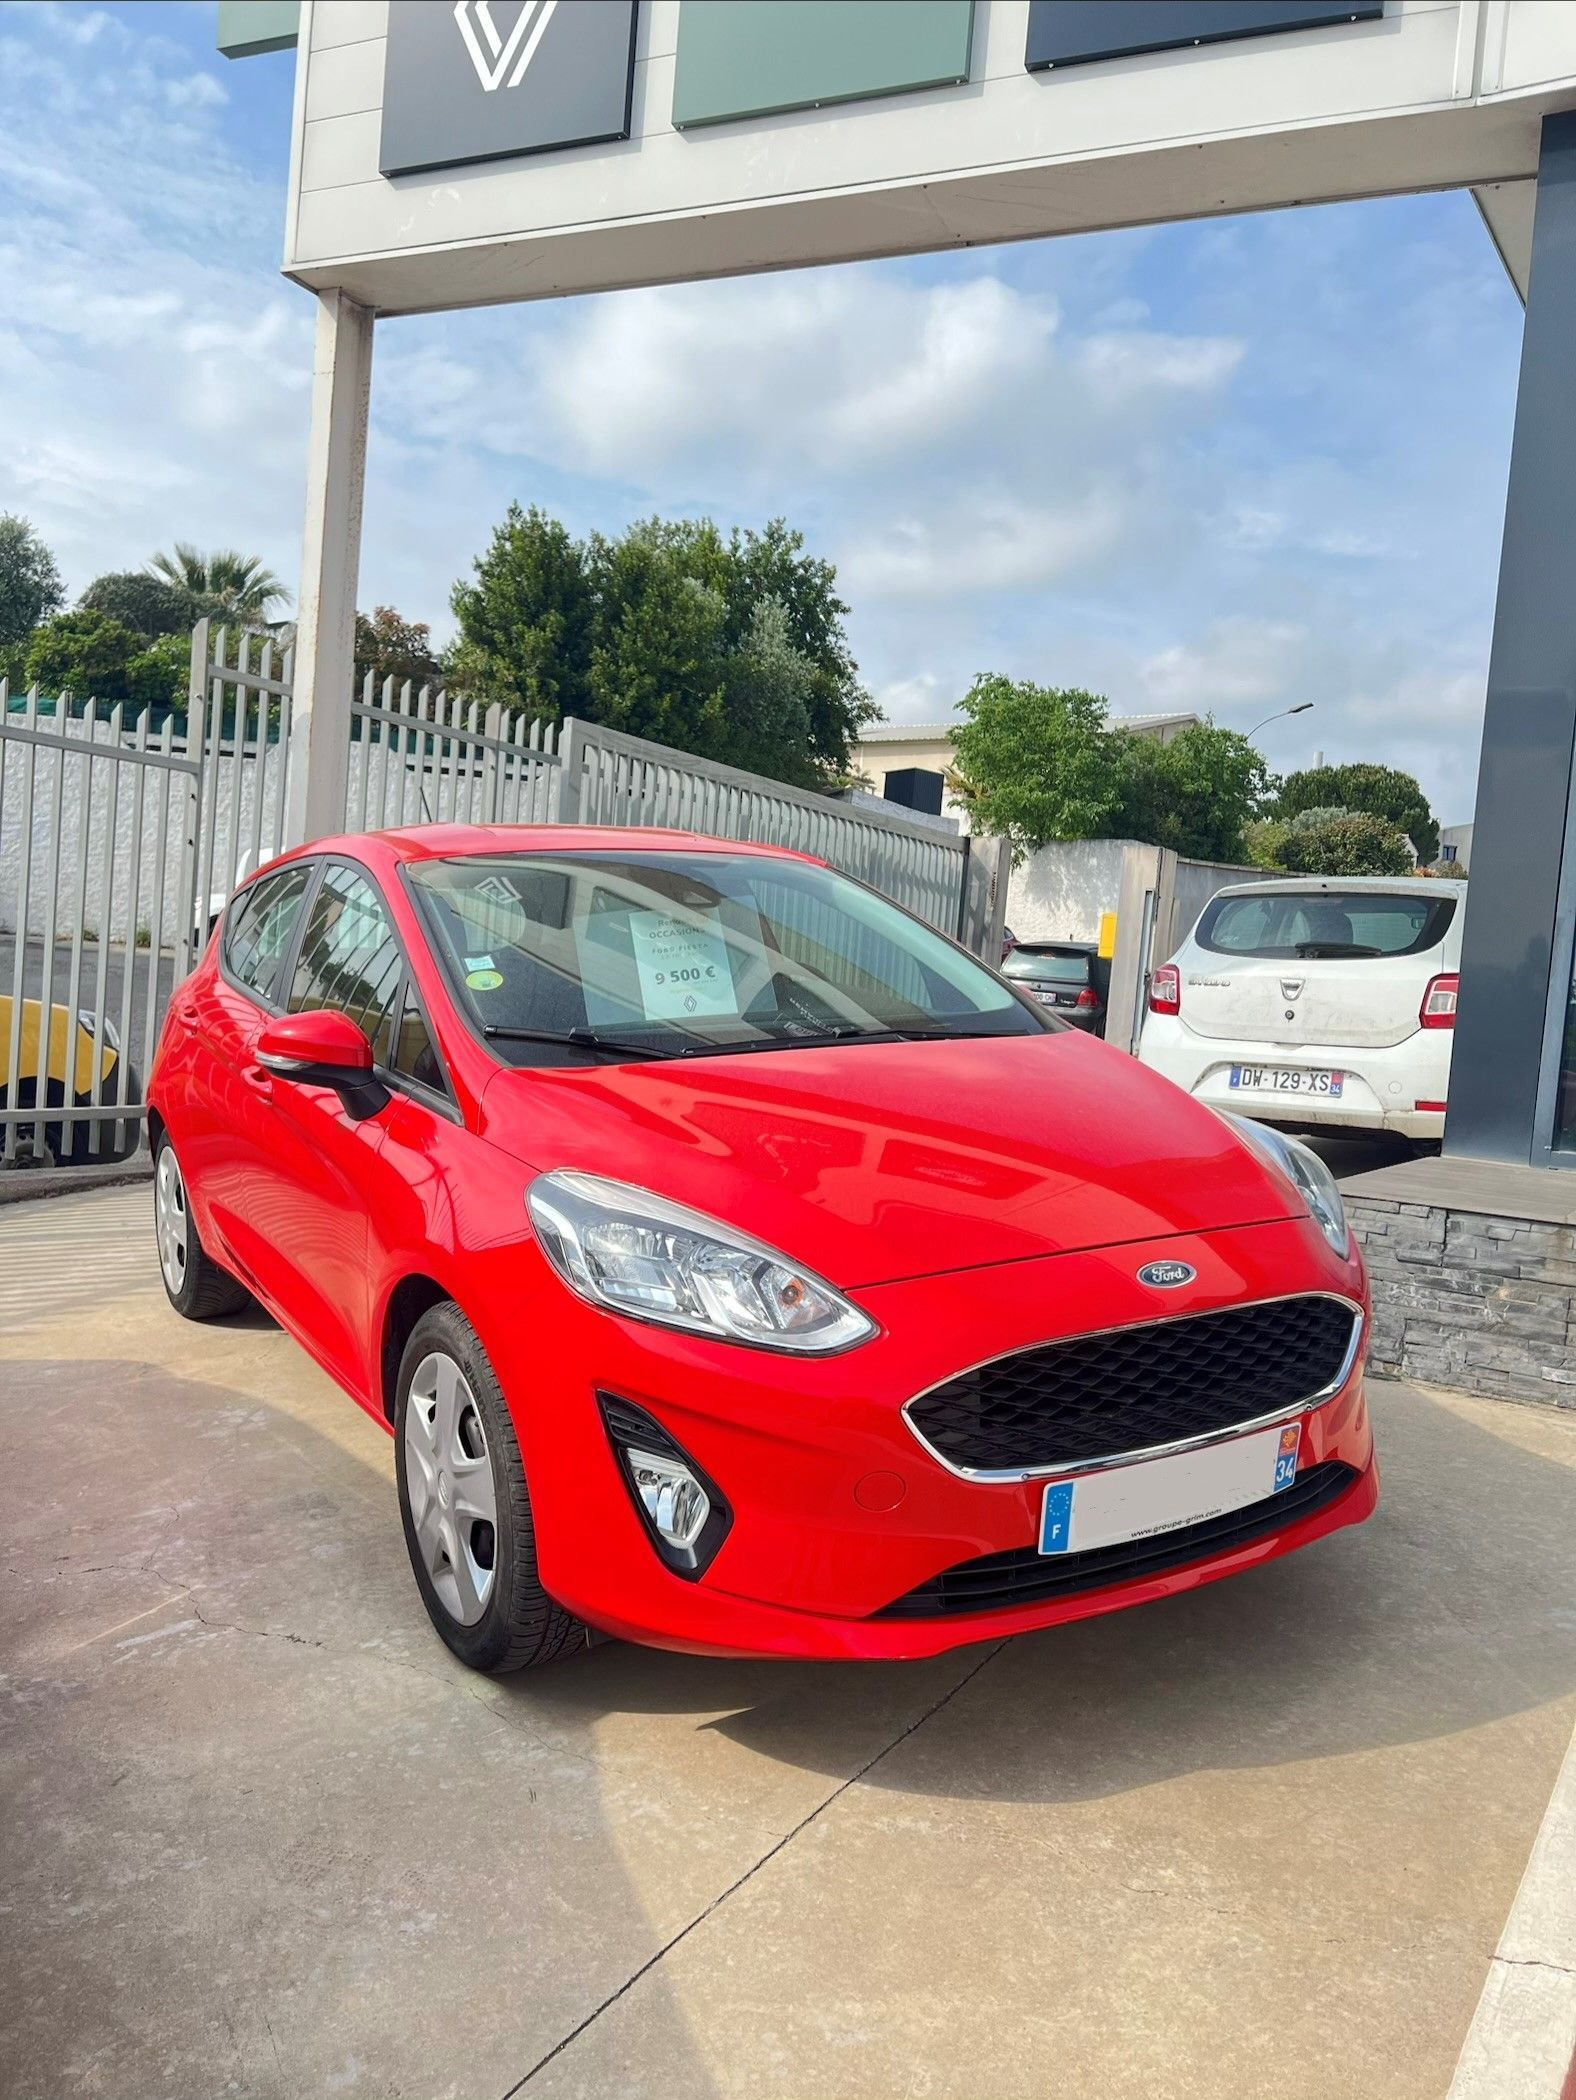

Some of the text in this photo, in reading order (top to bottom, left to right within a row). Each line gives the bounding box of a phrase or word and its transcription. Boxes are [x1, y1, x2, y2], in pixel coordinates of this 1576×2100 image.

[655, 972, 665, 985] 9
[670, 967, 700, 983] 500
[705, 966, 716, 978] €
[1242, 1068, 1329, 1092] DW-129-XS
[1331, 1084, 1340, 1093] 34
[1151, 1266, 1184, 1283] Ford
[1276, 1457, 1294, 1482] 34
[1052, 1524, 1061, 1539] F
[1131, 1508, 1222, 1537] www.groupe-grim.com
